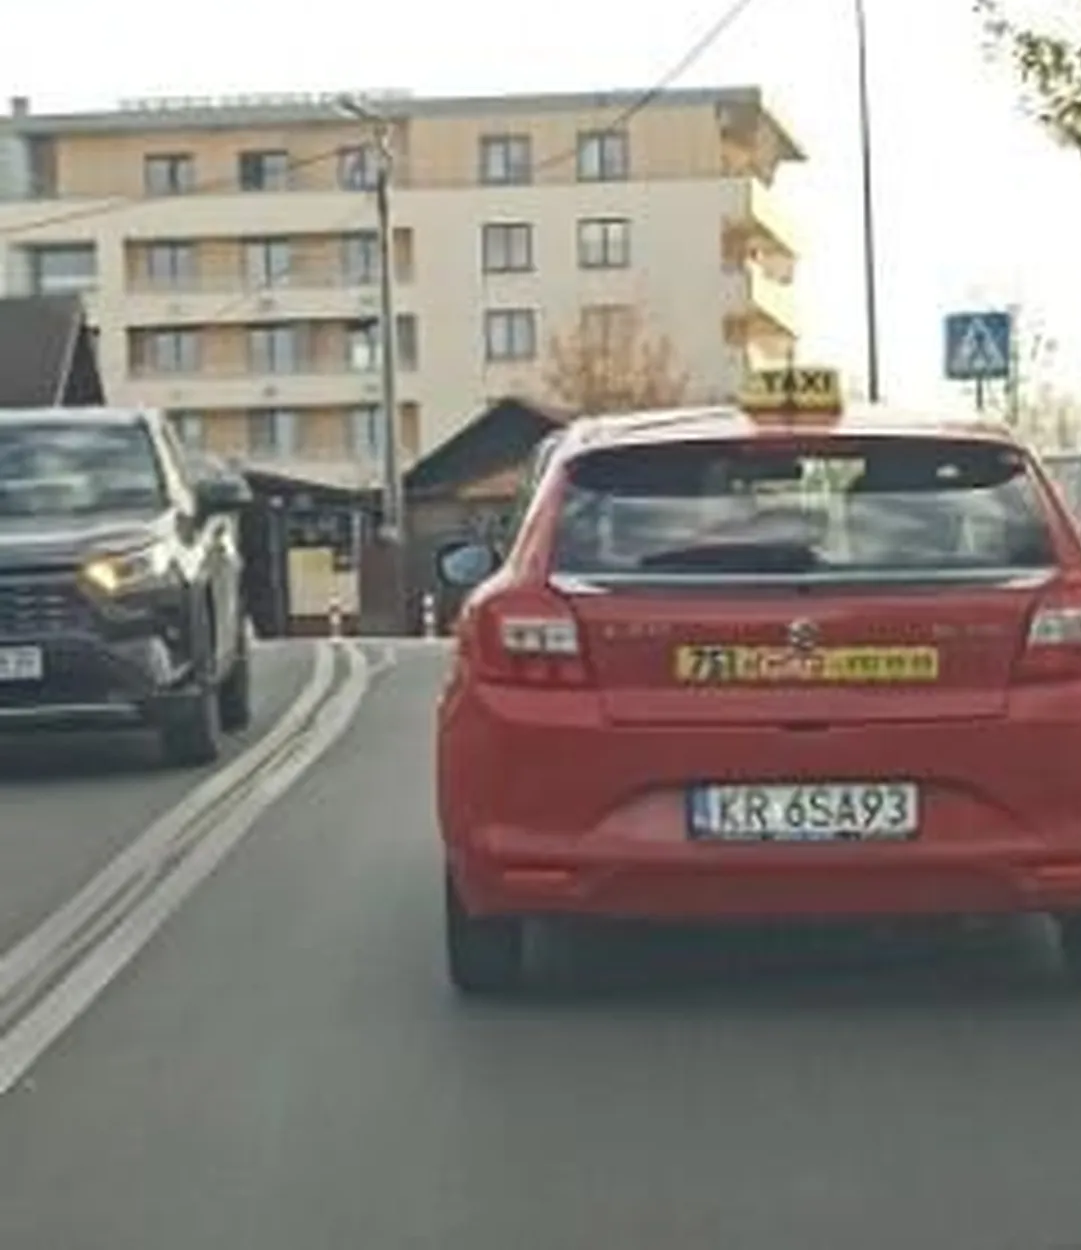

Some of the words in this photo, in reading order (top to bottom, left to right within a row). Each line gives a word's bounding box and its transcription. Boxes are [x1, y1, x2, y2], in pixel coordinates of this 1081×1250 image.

[760, 370, 831, 395] TAXI
[720, 789, 768, 829] KR
[786, 788, 907, 827] 6SA93
